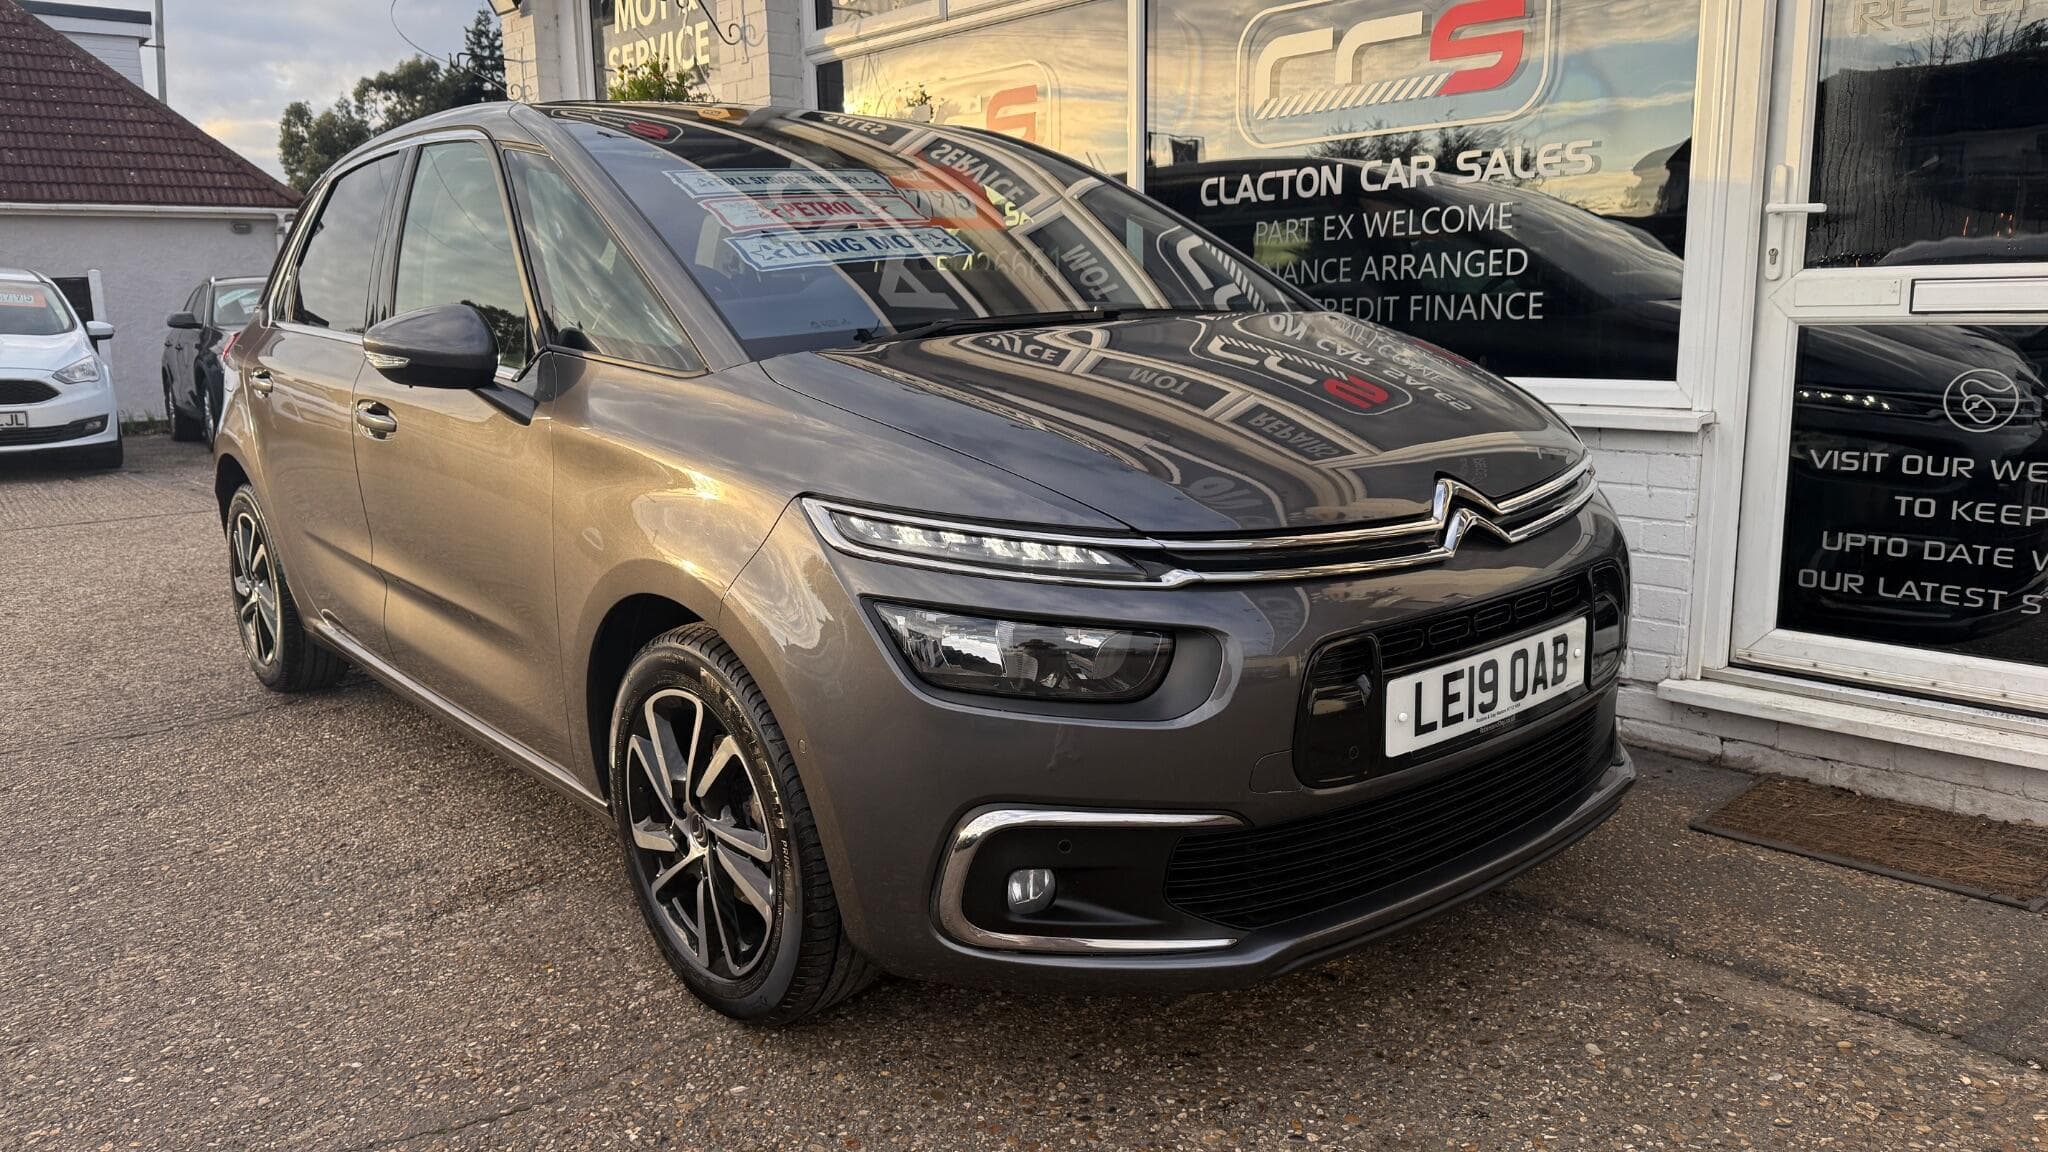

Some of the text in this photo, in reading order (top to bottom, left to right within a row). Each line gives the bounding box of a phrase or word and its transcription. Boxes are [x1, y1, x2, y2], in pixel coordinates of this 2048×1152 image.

[1200, 139, 1593, 207] CLACTON CAR SALES
[779, 201, 864, 219] PETROL
[1255, 202, 1513, 247] PART EX WELCOME
[787, 237, 868, 258] LONG
[1360, 248, 1528, 283] ARRANGED
[1311, 291, 1544, 322] REDIT FINANCE
[1810, 449, 1889, 474] VISIT
[1901, 454, 1976, 479] OUR
[1894, 495, 2048, 527] TO KEEP
[1821, 530, 1909, 558] UPTO
[1923, 540, 2015, 569] DATE
[1798, 568, 1864, 595] OUR
[1878, 577, 2008, 611] LATEST
[1415, 658, 1499, 737] LE19
